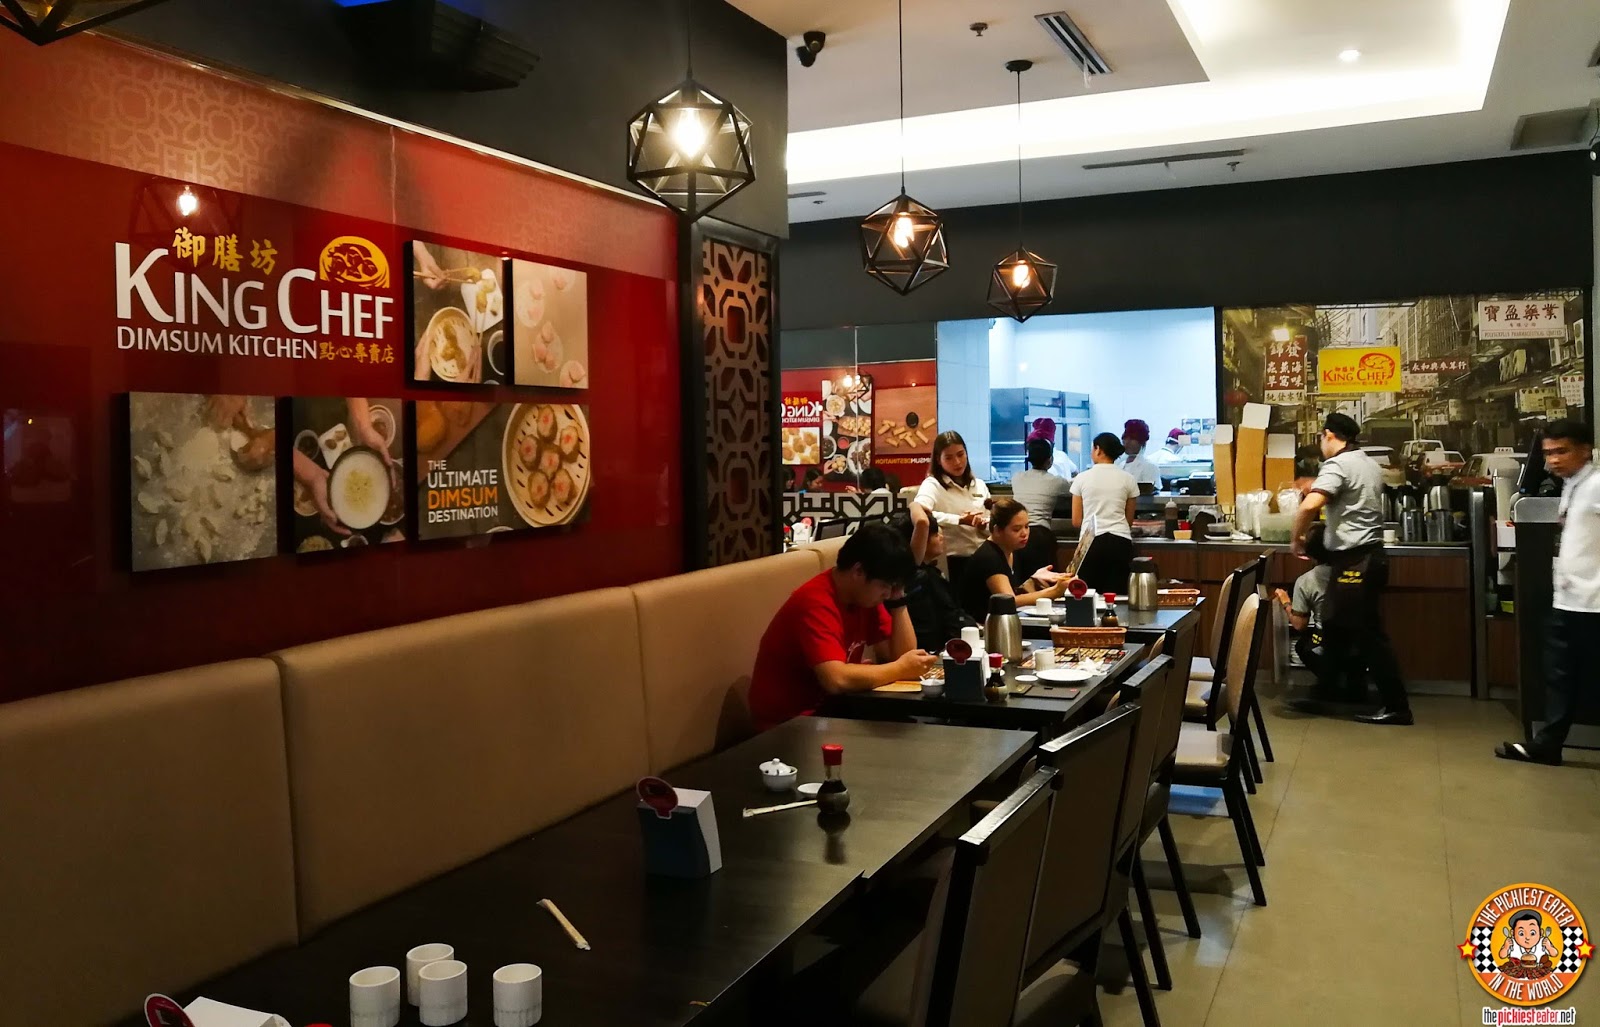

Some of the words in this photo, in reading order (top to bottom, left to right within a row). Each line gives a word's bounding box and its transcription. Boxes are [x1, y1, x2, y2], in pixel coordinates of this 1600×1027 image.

[172, 226, 278, 275] 御膳坊
[115, 242, 268, 330] KING
[277, 268, 394, 339] CHEF
[117, 326, 223, 354] DIMSUM
[229, 334, 317, 360] KITCHEN
[319, 341, 395, 364] 點心專賣店
[1323, 369, 1354, 382] KING
[1356, 368, 1387, 381] CHEF
[427, 460, 447, 471] THE
[427, 469, 498, 489] ULTIMATE
[427, 486, 498, 510] DIMSUM
[428, 505, 499, 524] DESTINATION
